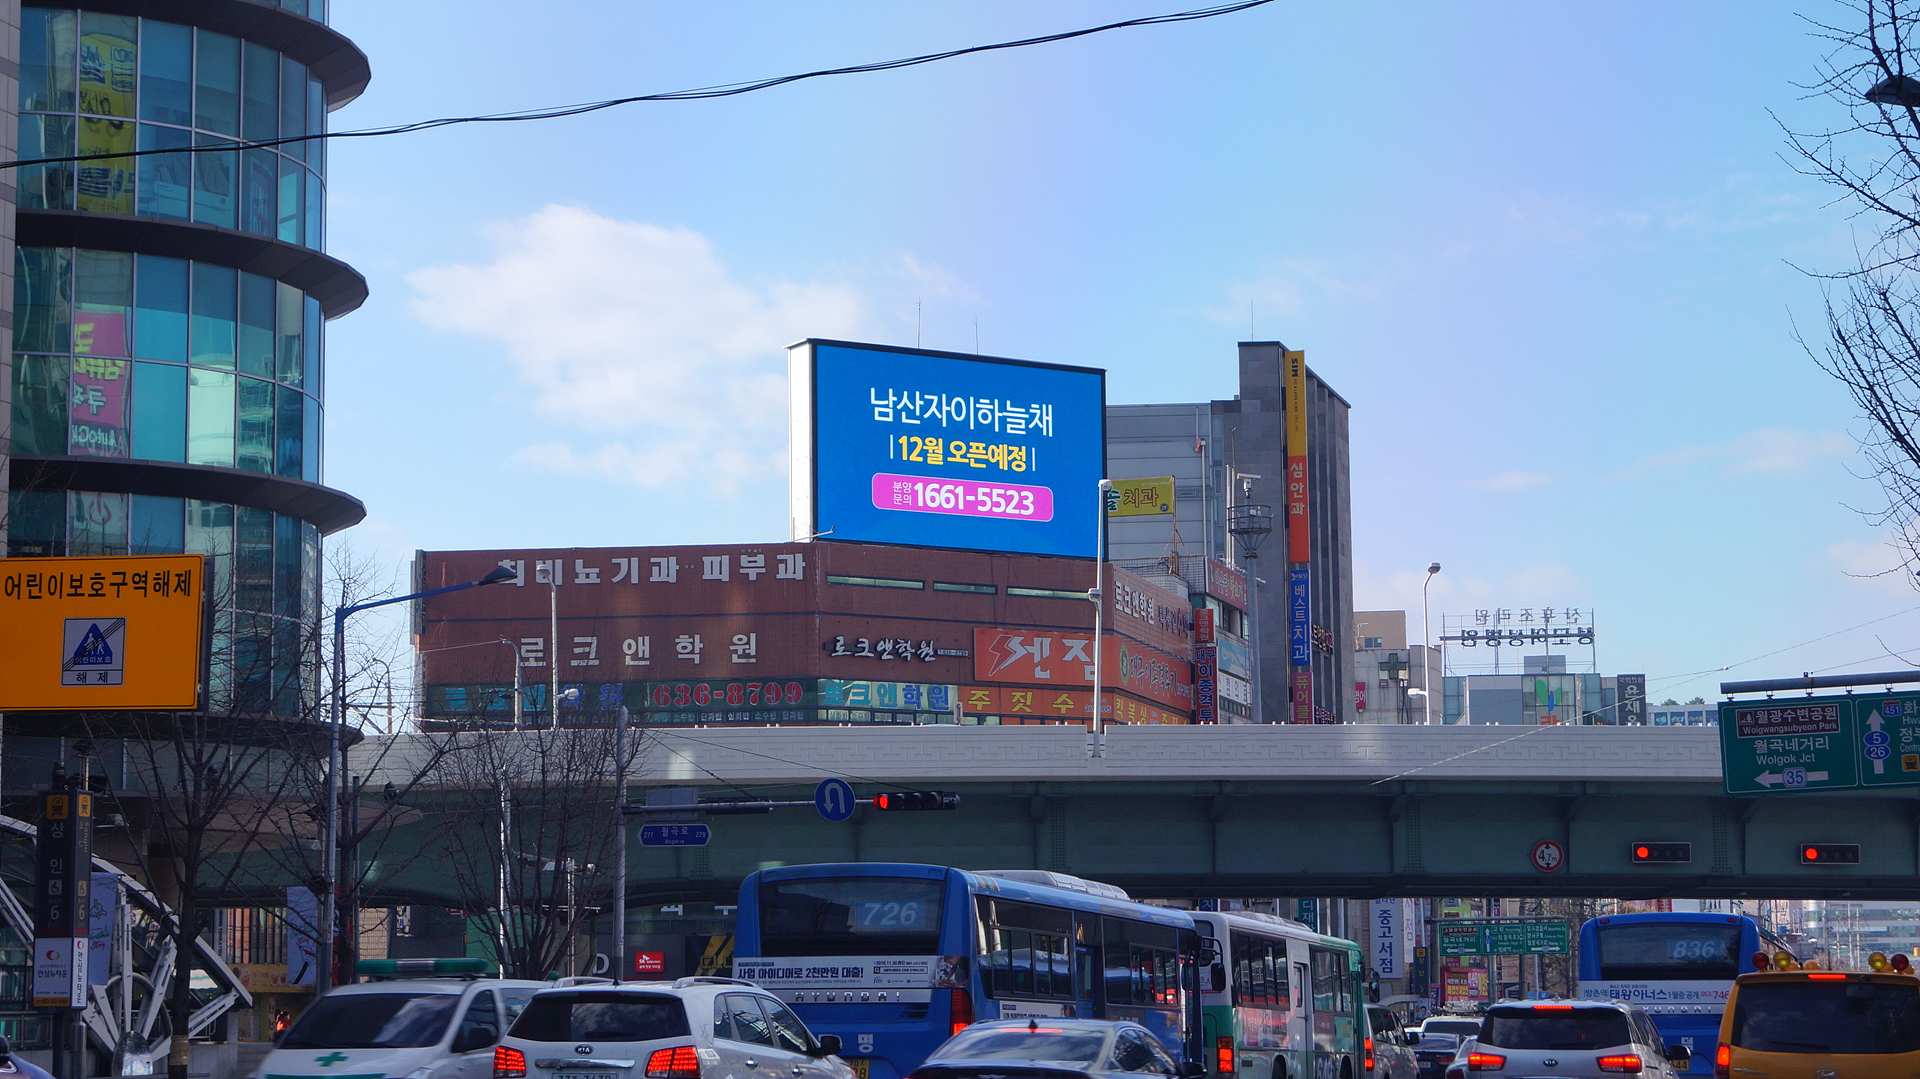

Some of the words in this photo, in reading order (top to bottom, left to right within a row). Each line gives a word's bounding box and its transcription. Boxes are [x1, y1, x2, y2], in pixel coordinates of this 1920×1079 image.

[870, 387, 1053, 438] 남산자이하늘채
[898, 436, 944, 465] 12월
[947, 440, 1027, 472] 오픈예정
[913, 482, 1035, 516] 1661-5523
[1123, 487, 1160, 508] 치과
[1291, 463, 1305, 516] 심안과
[702, 552, 806, 582] 피부과
[4, 569, 192, 600] 어린이보호구역해제
[1293, 584, 1309, 662] 베스트치과
[518, 632, 758, 668] 로크앤학원
[831, 635, 937, 662] 로크앤학원
[653, 681, 804, 708] 636-8799
[967, 689, 1075, 714] 주짓수
[1756, 706, 1837, 724] 월광수변공원
[1903, 700, 1920, 716] 화
[1819, 721, 1837, 730] Park
[1753, 736, 1830, 754] 월곡네거리
[1872, 733, 1881, 744] 5
[1756, 754, 1797, 767] Wolgok
[1799, 752, 1816, 764] Jct
[1870, 746, 1885, 758] 26
[1786, 770, 1804, 785] 35
[50, 905, 60, 920] 6
[863, 901, 918, 926] 726
[1377, 908, 1393, 973] 중고서점
[1673, 940, 1714, 959] 836
[738, 967, 756, 979] 사업
[758, 967, 803, 979] 아이디어로
[805, 967, 839, 979] 2천만원
[841, 967, 864, 979] 대출!
[794, 991, 902, 1003] HYUNDAI
[1609, 989, 1667, 1001] 태왕아너스
[1642, 1005, 1713, 1015] YUNDAI
